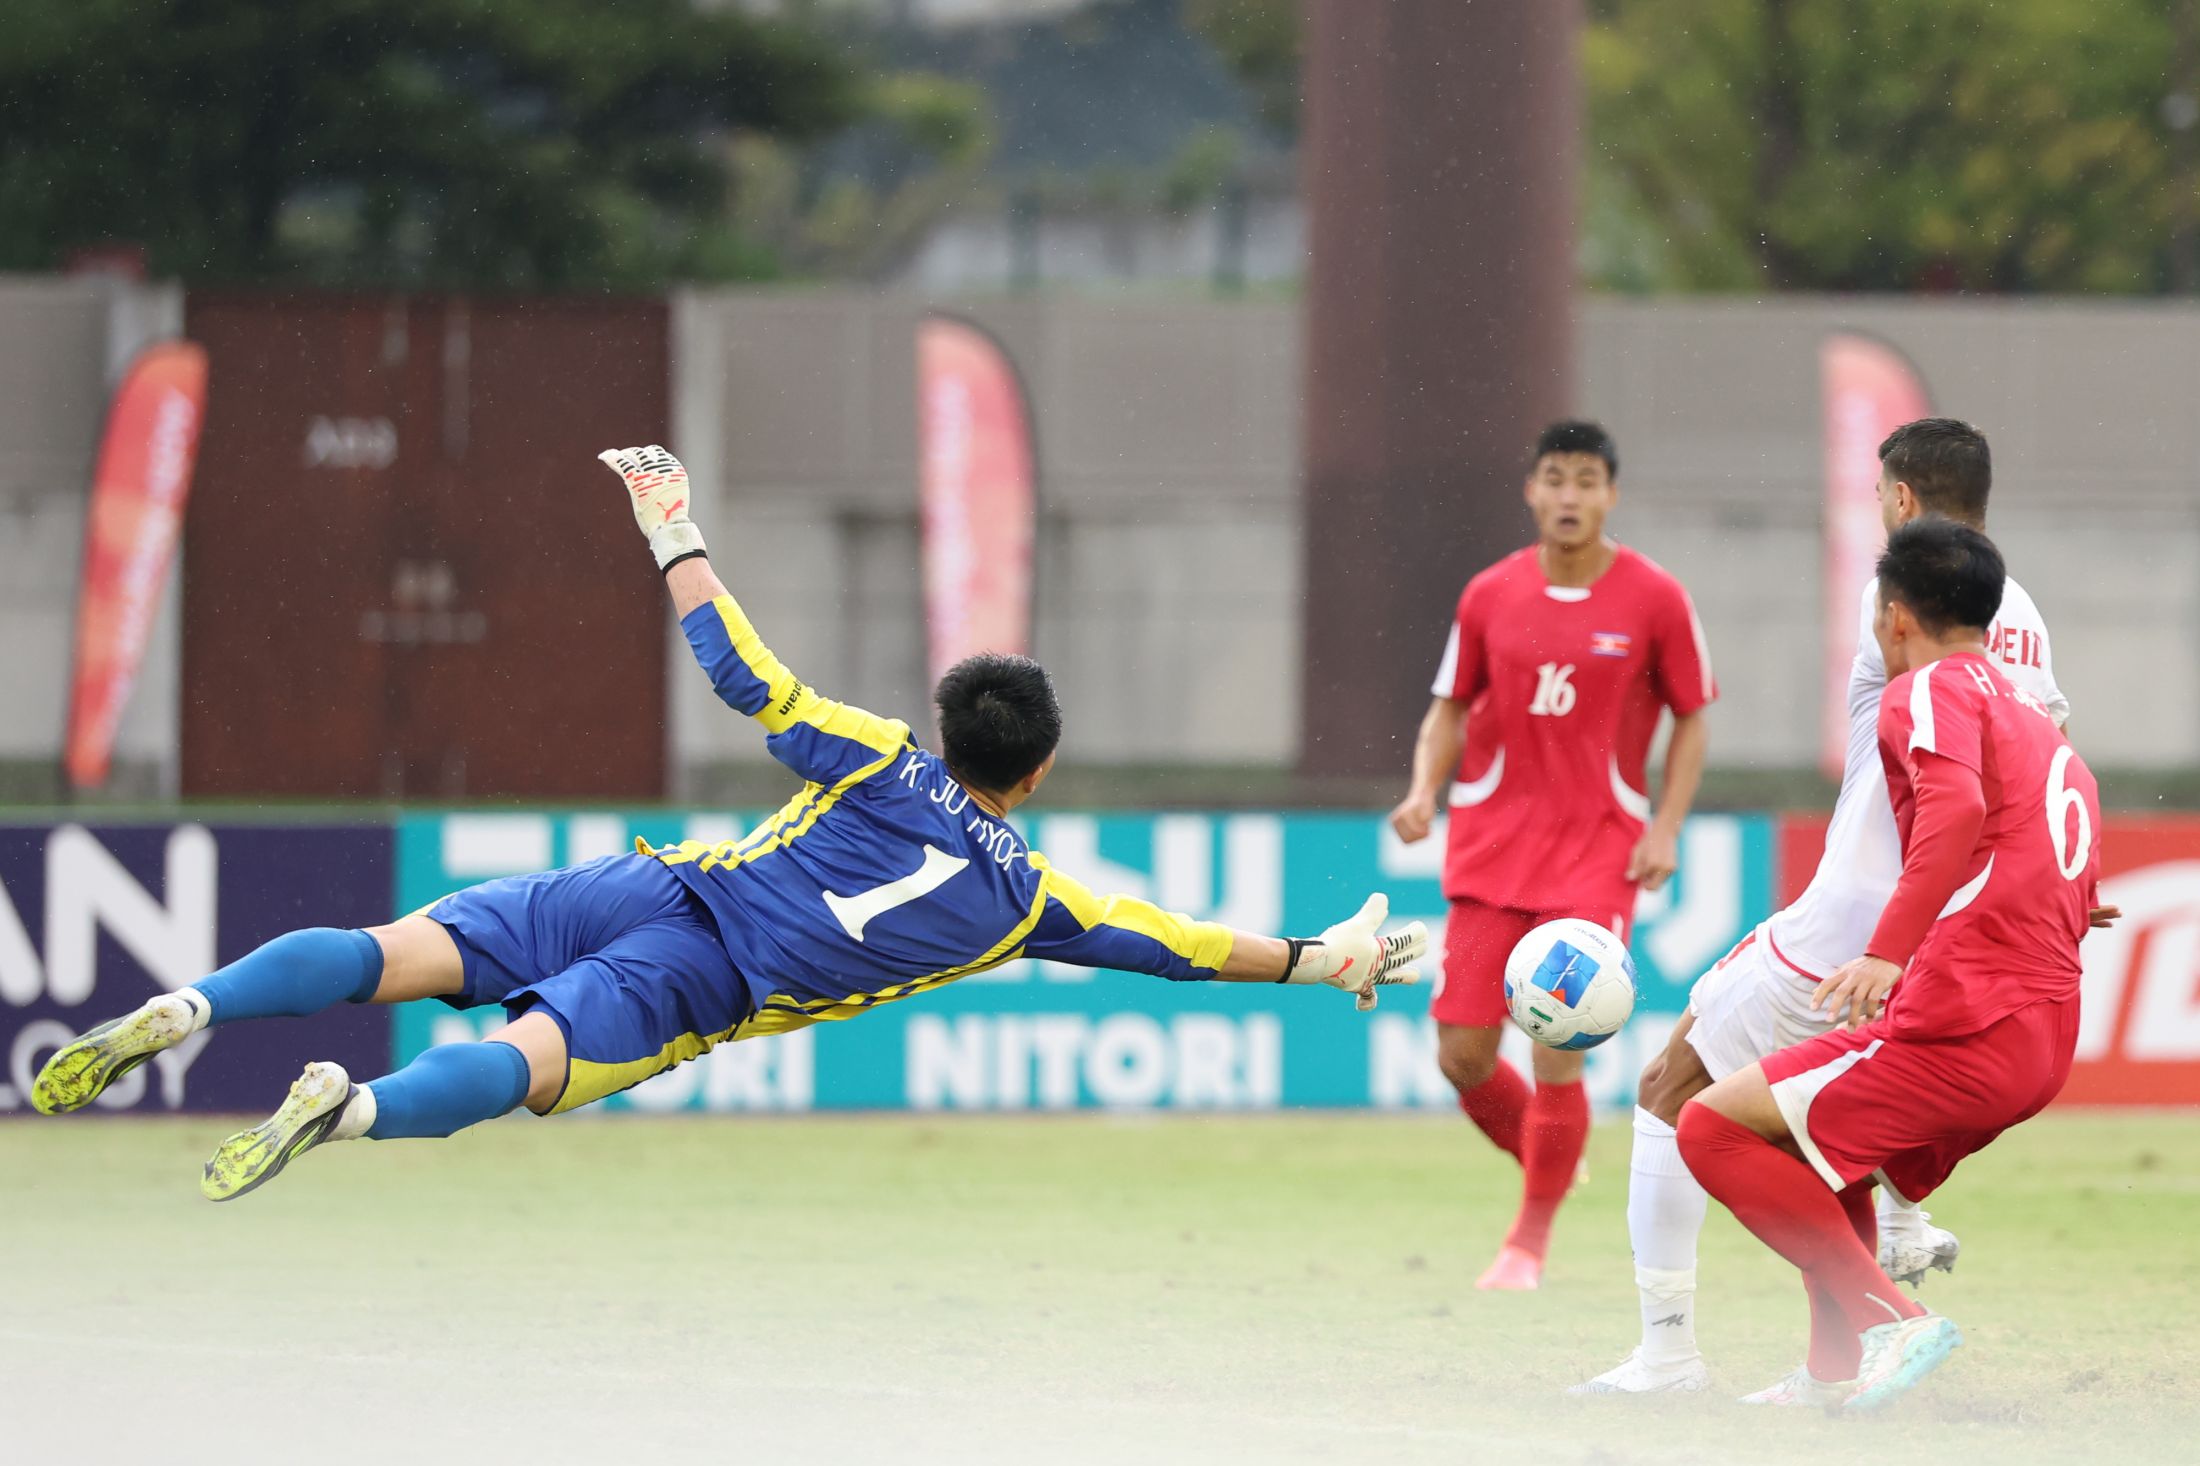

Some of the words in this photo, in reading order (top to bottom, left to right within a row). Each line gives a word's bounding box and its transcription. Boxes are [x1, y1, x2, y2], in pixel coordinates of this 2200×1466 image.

[778, 679, 802, 716] ptain
[1529, 661, 1577, 717] 16
[930, 775, 970, 815] JU
[966, 815, 1025, 872] HYOK
[2046, 745, 2093, 881] 6
[0, 823, 219, 1007] N
[822, 843, 970, 943] 1
[905, 1013, 1284, 1109] NITORI
